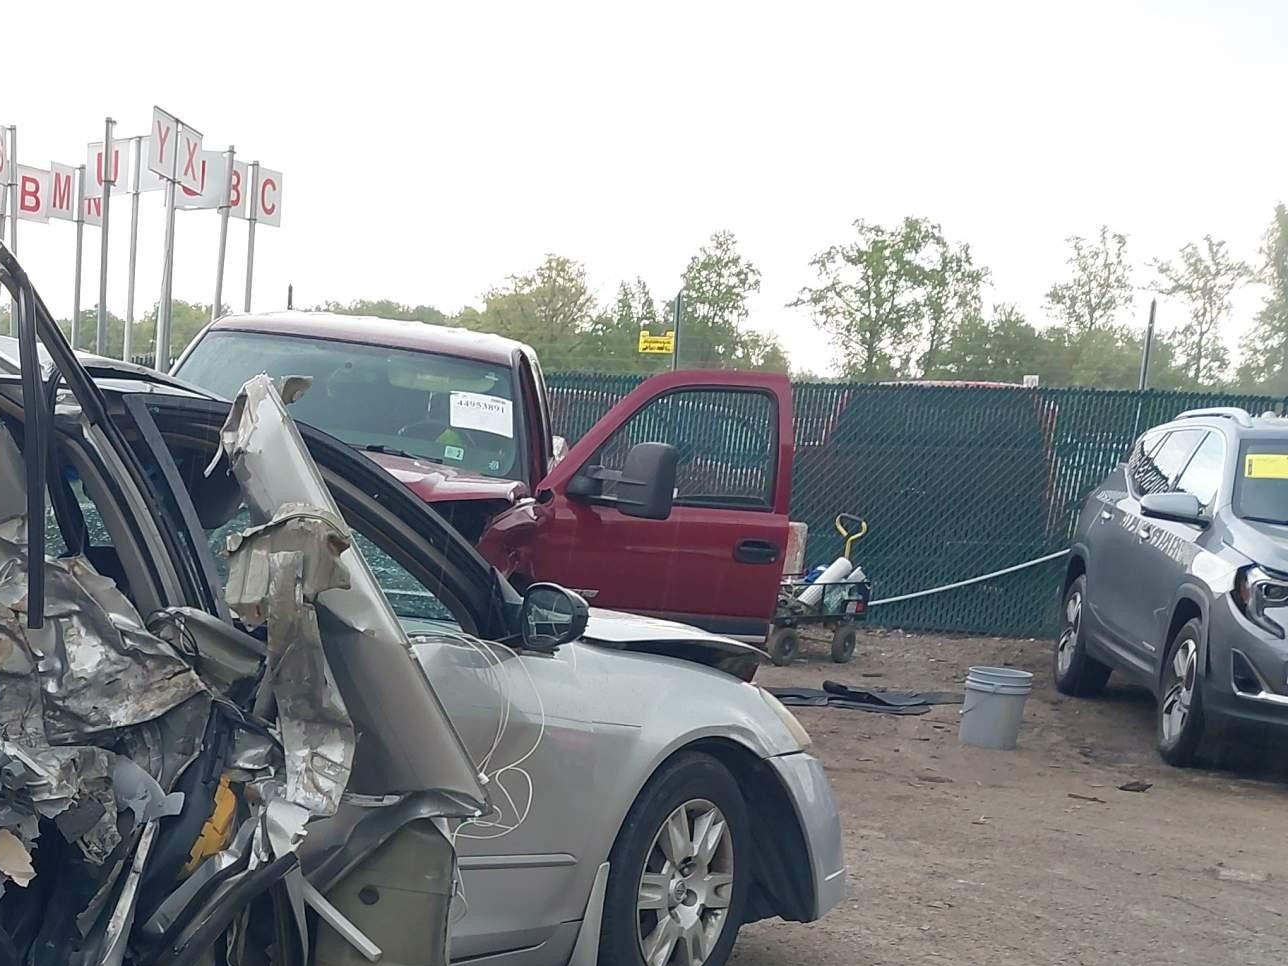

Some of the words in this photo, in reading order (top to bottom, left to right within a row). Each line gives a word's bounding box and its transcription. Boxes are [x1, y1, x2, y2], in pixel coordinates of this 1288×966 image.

[157, 120, 170, 163] Y
[183, 137, 198, 181] X
[96, 149, 119, 187] U
[19, 175, 41, 213] B
[52, 172, 72, 211] M
[261, 178, 277, 215] C
[456, 399, 505, 414] 44953891
